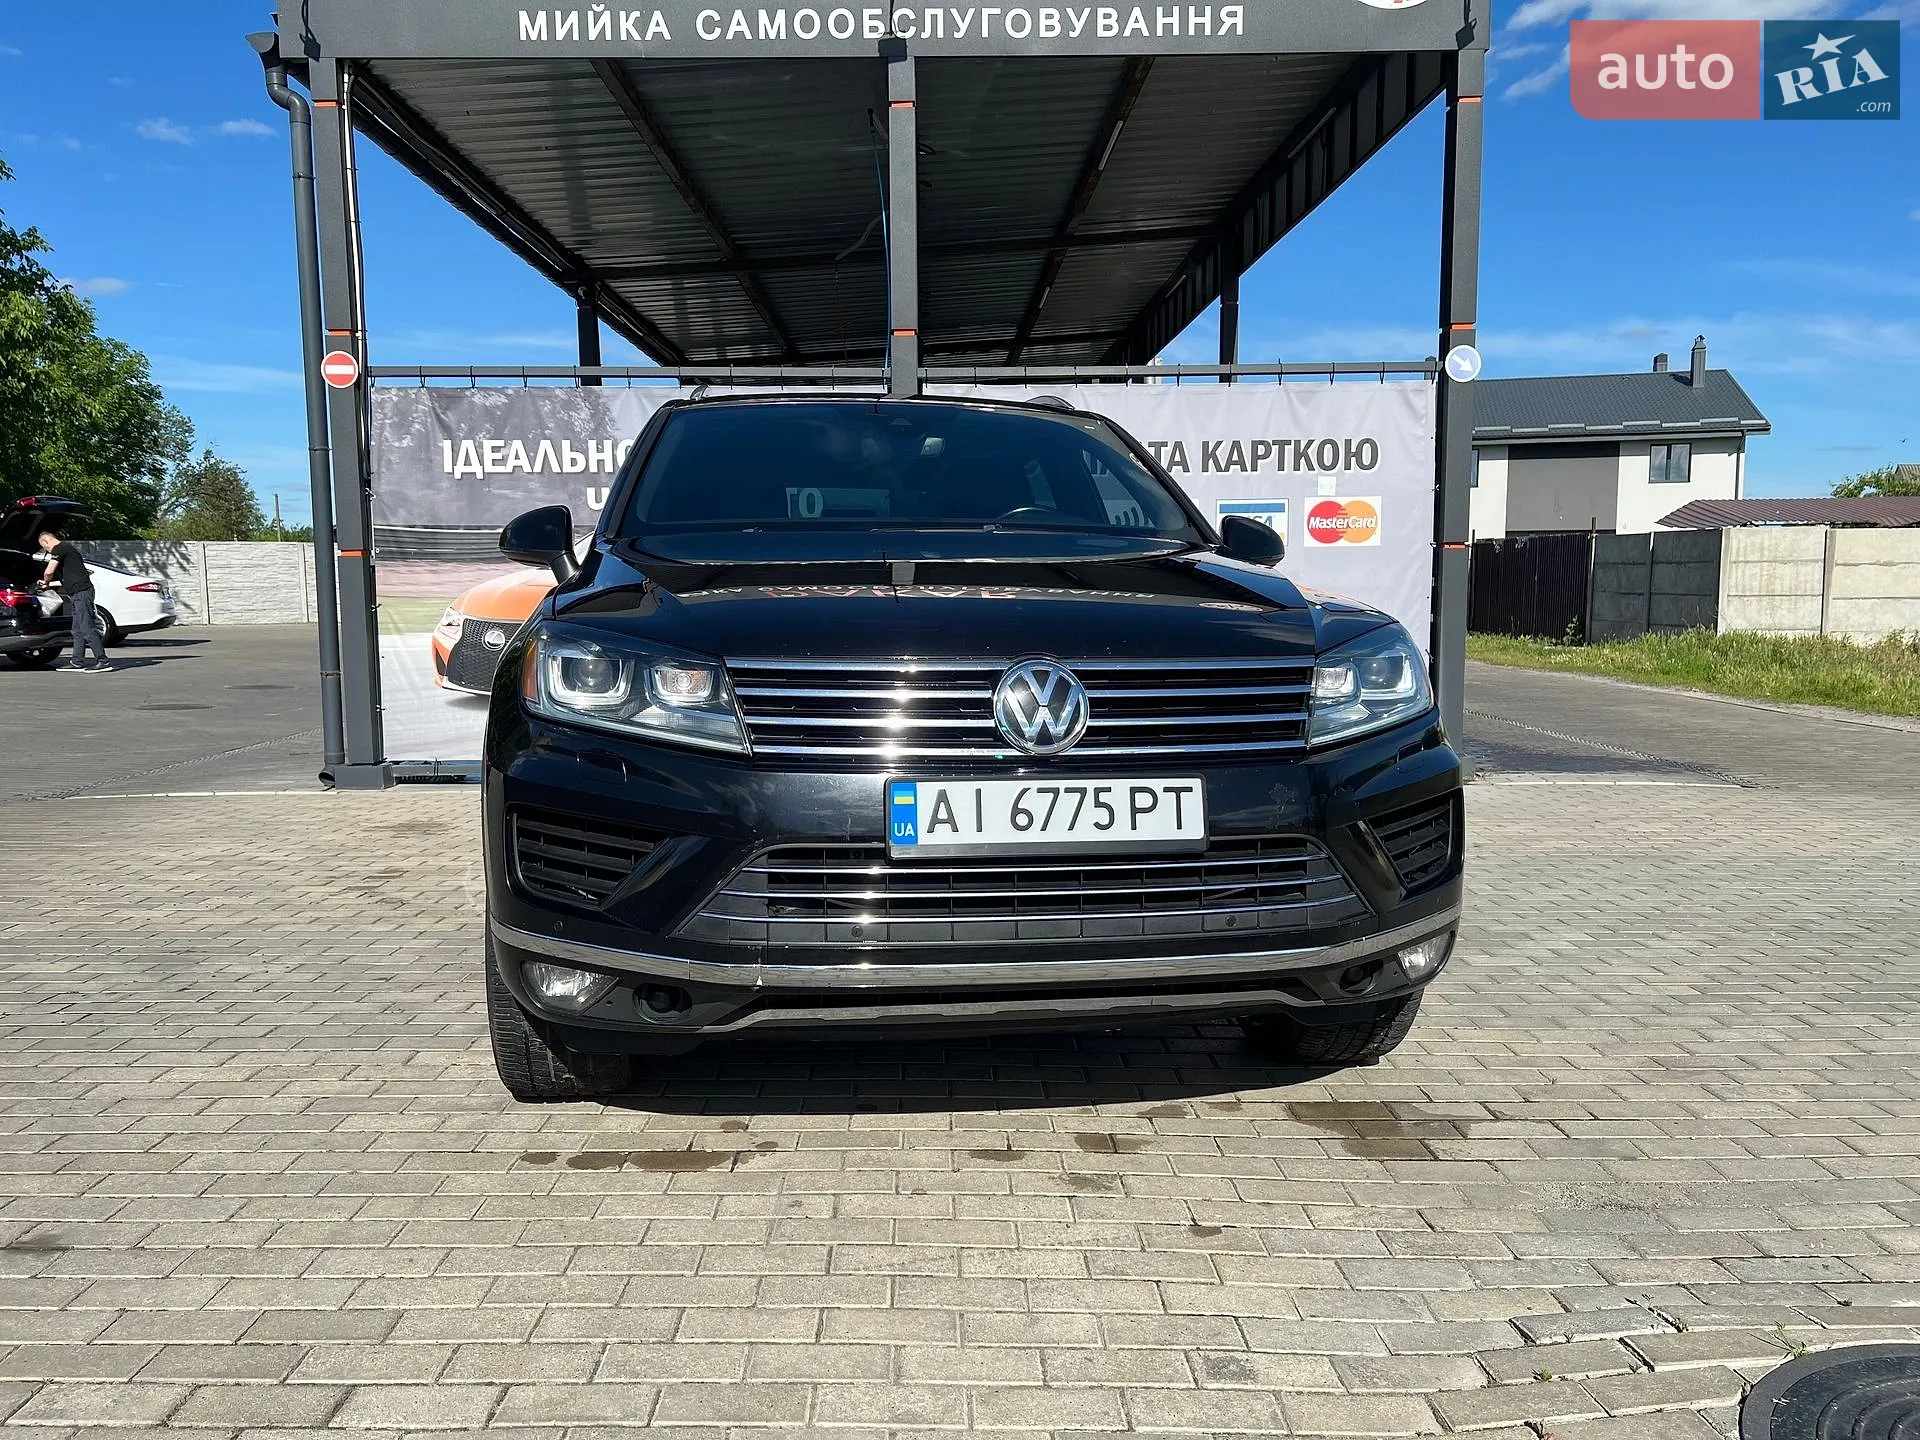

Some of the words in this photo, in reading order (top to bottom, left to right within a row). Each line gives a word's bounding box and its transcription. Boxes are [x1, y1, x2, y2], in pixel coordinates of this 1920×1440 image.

[518, 3, 672, 41] МИЙКА
[695, 4, 1245, 41] САМООБСЛУГОВУВАННЯ
[1200, 437, 1380, 473] КАРТКОЮ
[1308, 515, 1377, 531] MasterCard
[926, 788, 983, 834] AI
[1010, 786, 1116, 832] 6775
[1129, 786, 1194, 831] PT
[894, 822, 915, 837] UA
